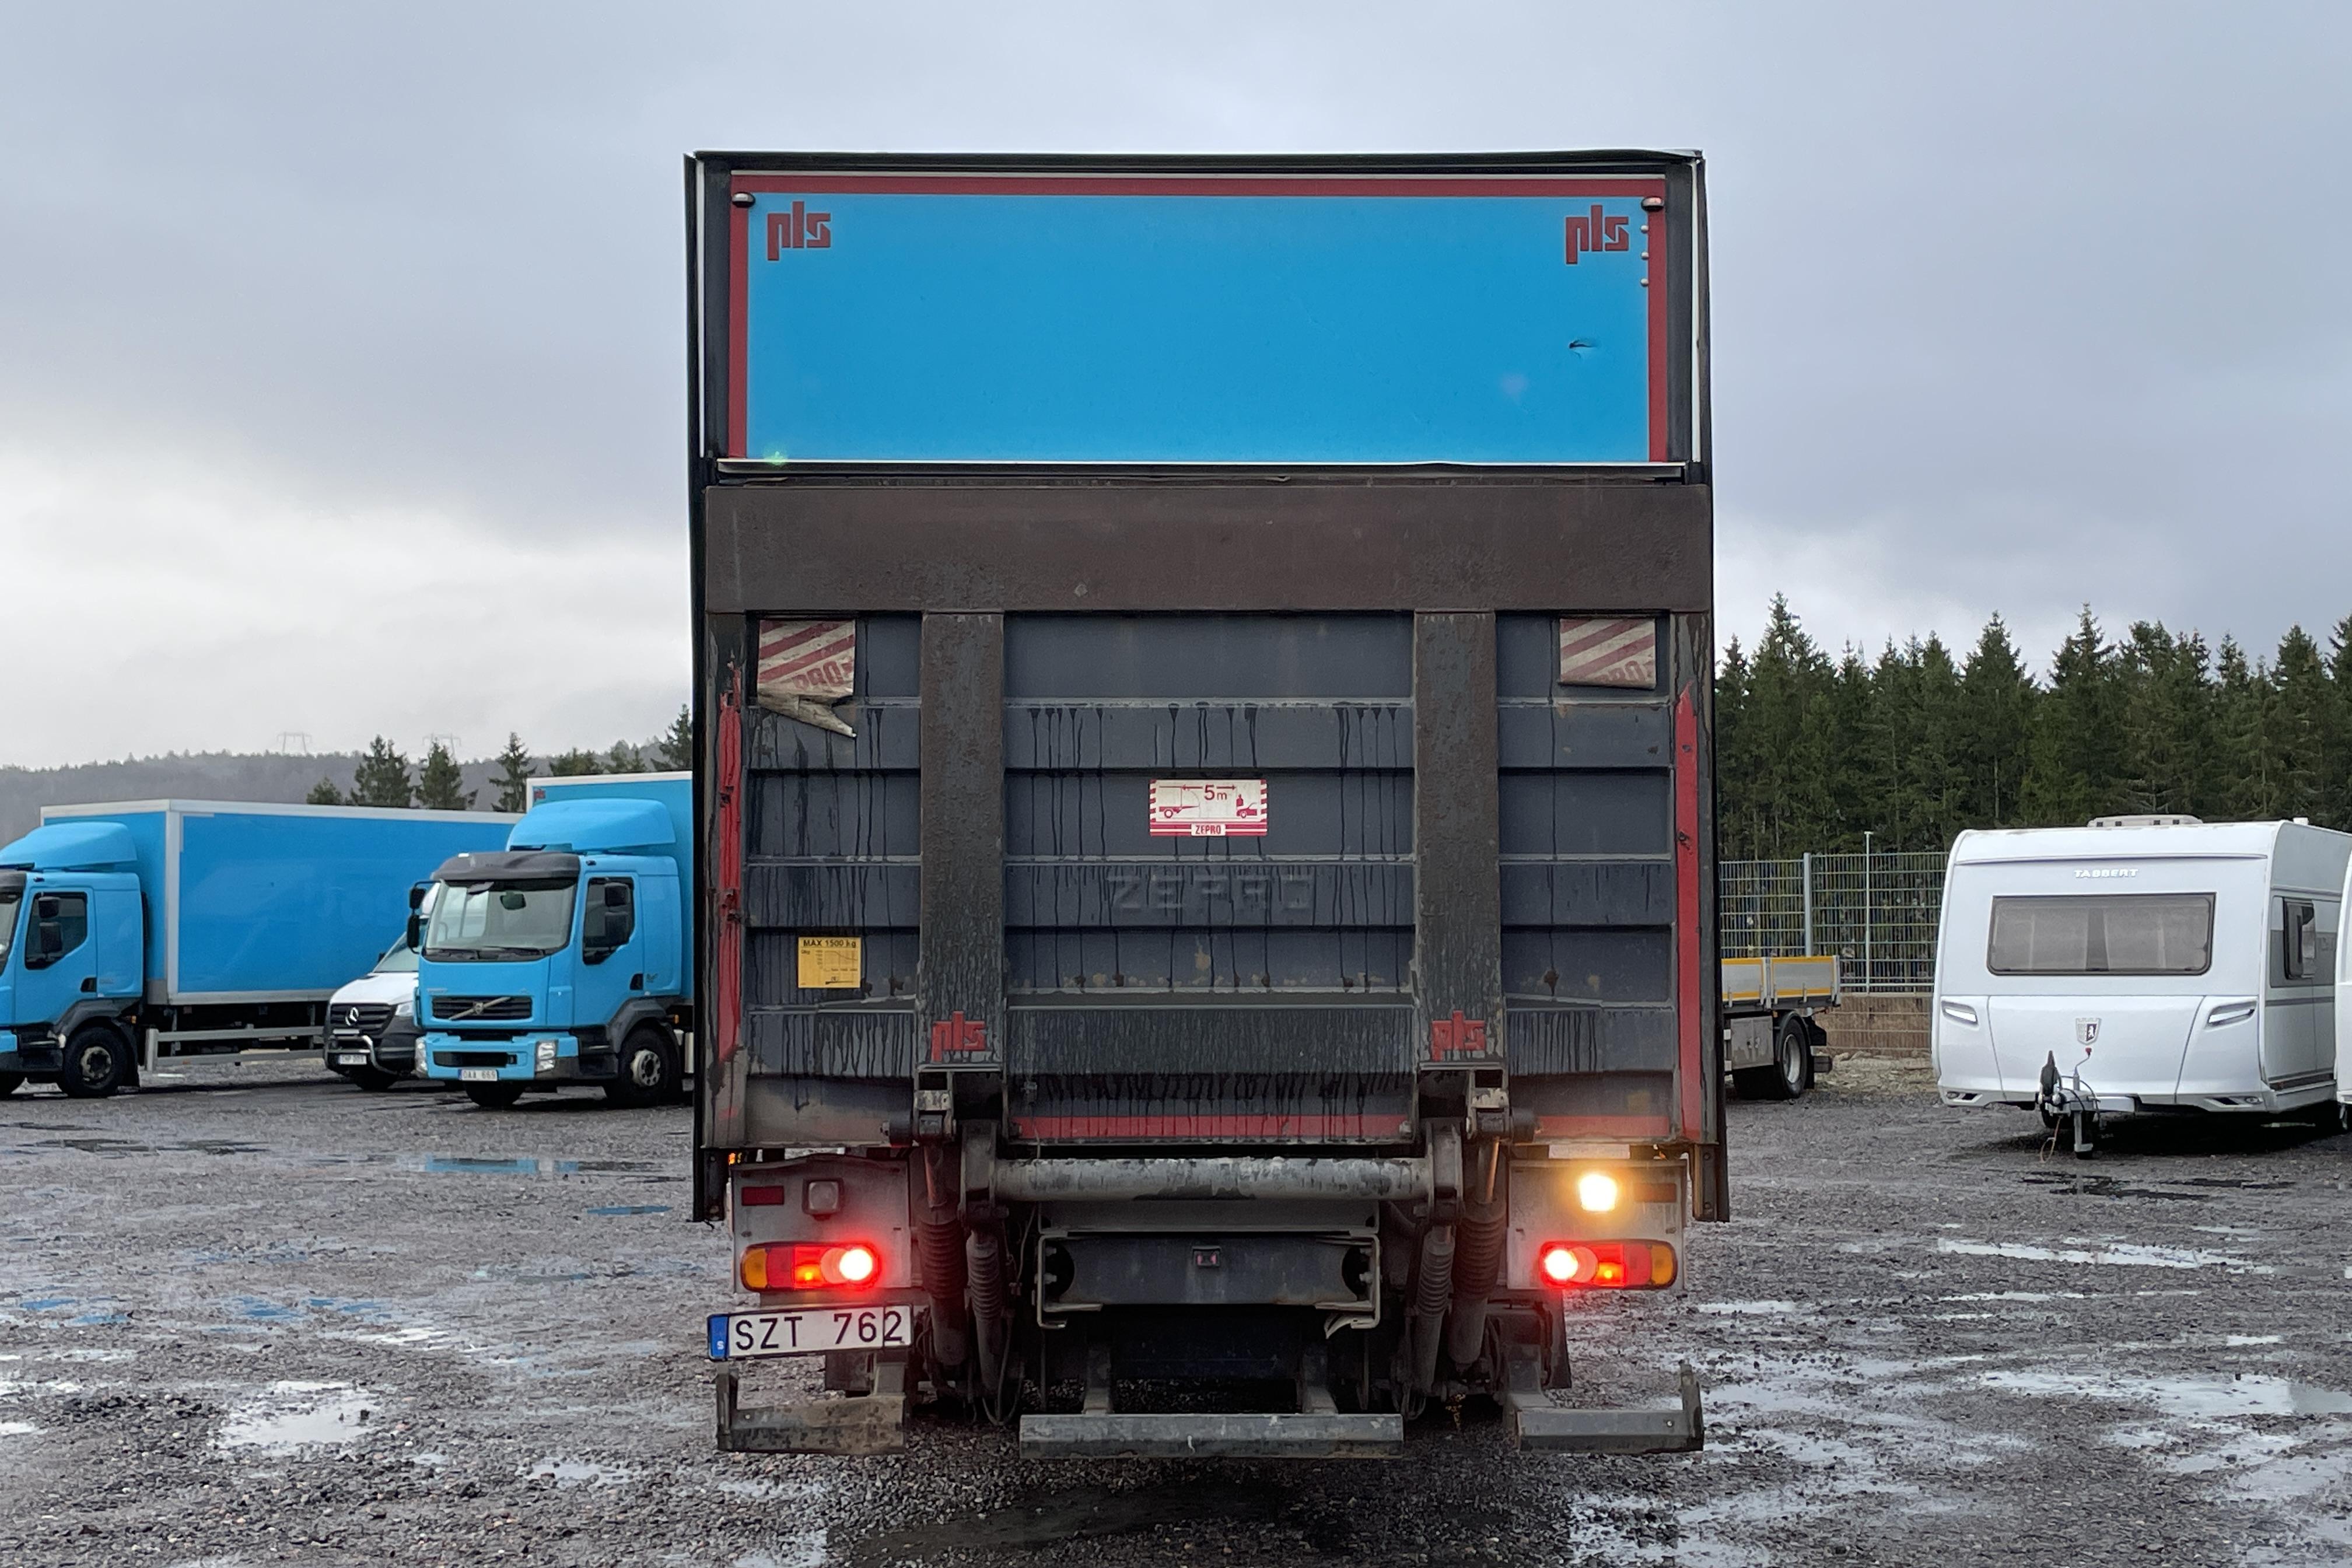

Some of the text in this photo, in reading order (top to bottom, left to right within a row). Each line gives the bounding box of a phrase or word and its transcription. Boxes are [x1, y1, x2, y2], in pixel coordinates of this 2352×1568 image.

[767, 201, 831, 261] pls
[1565, 205, 1629, 264] pls
[1195, 824, 1222, 835] ZEPRO
[1106, 874, 1314, 909] ZEPRO
[2074, 869, 2139, 879] TABBERT
[824, 939, 845, 947] 1500
[846, 939, 857, 949] kg
[931, 1010, 986, 1062] pls
[1431, 1009, 1485, 1062] pls
[716, 1340, 724, 1350] S
[735, 1310, 903, 1350] SZT 762
